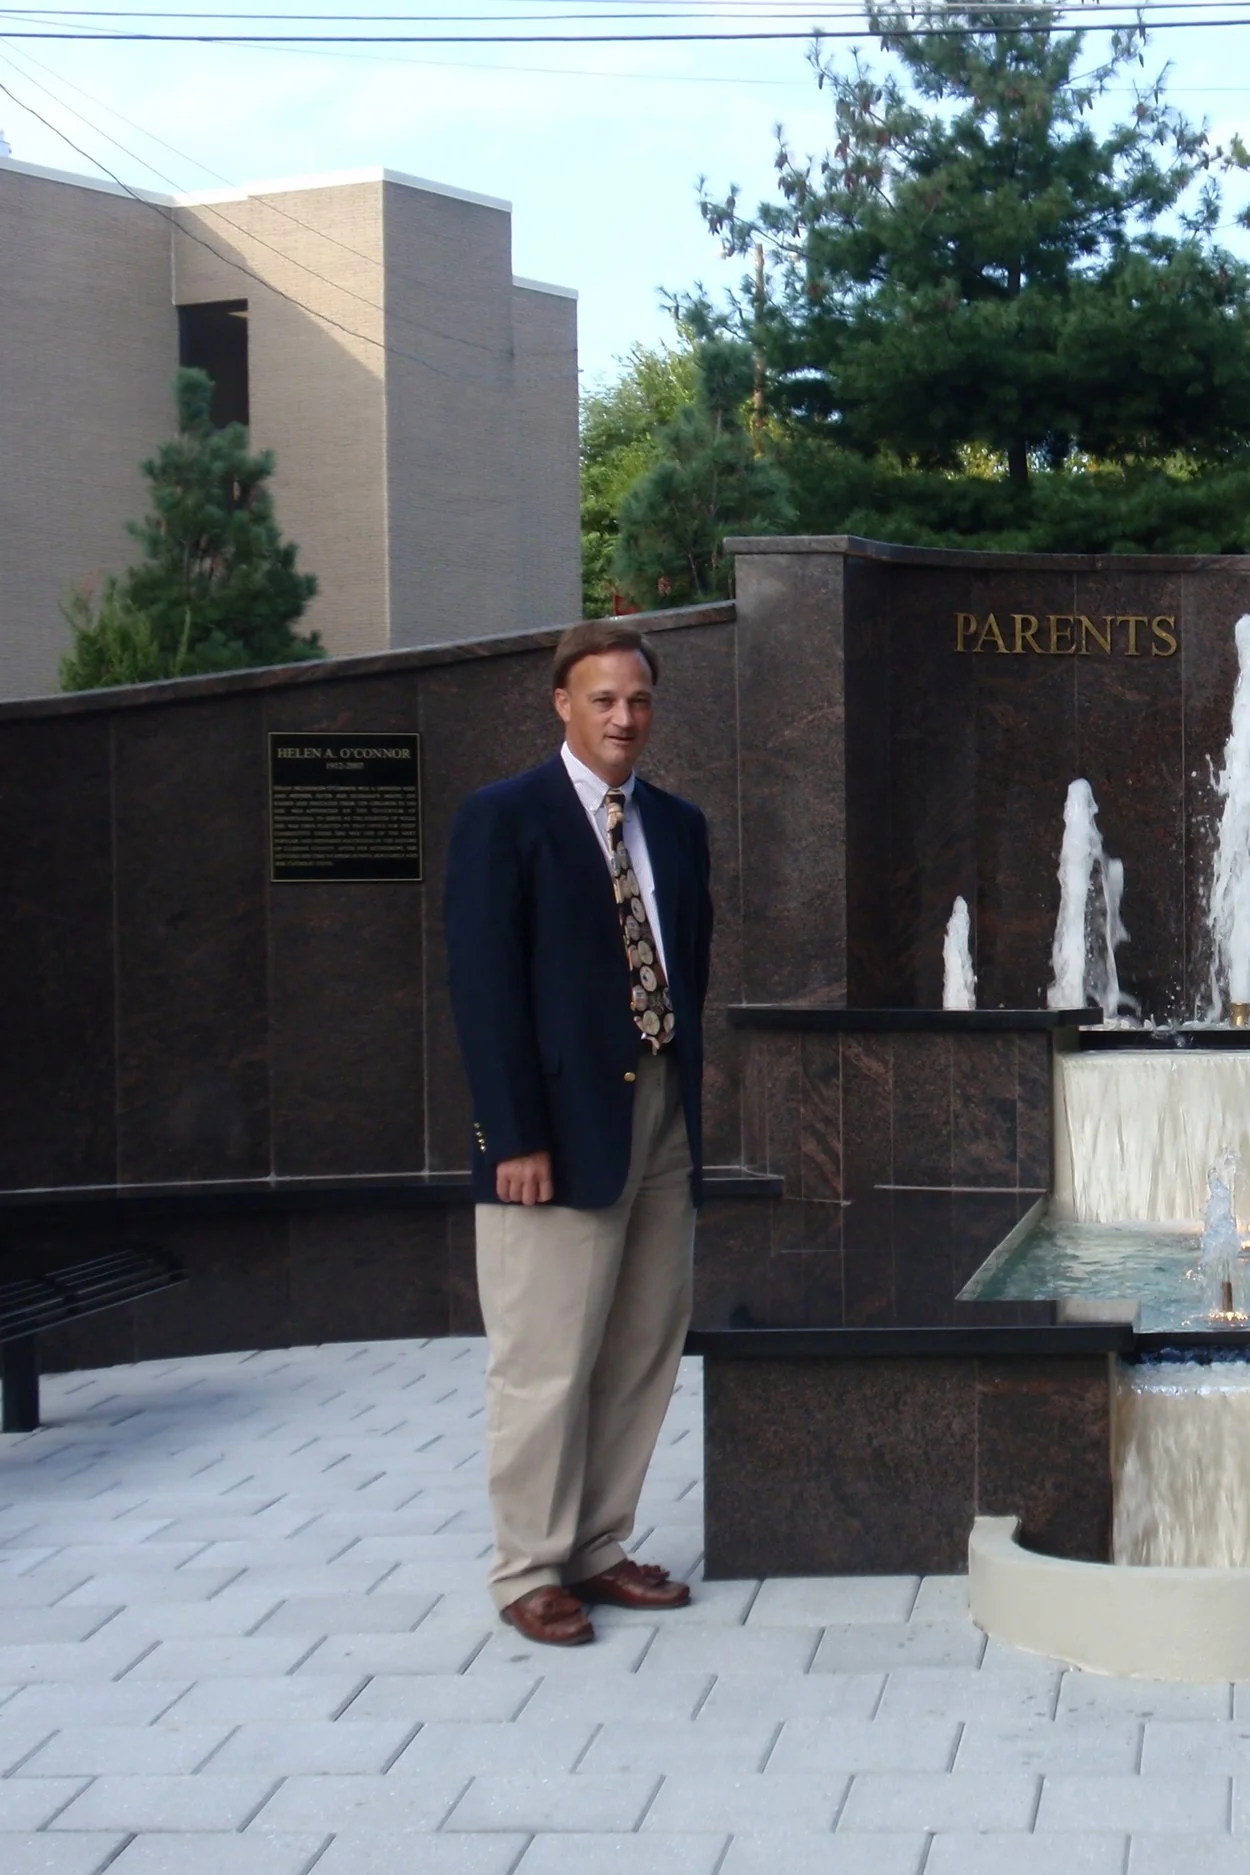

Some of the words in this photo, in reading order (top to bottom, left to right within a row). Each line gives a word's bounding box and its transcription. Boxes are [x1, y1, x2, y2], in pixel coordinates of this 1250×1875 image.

[953, 612, 1177, 656] PARENTS
[277, 748, 321, 759] HELEN
[324, 748, 337, 758] A.
[340, 748, 411, 759] O'CONNOR
